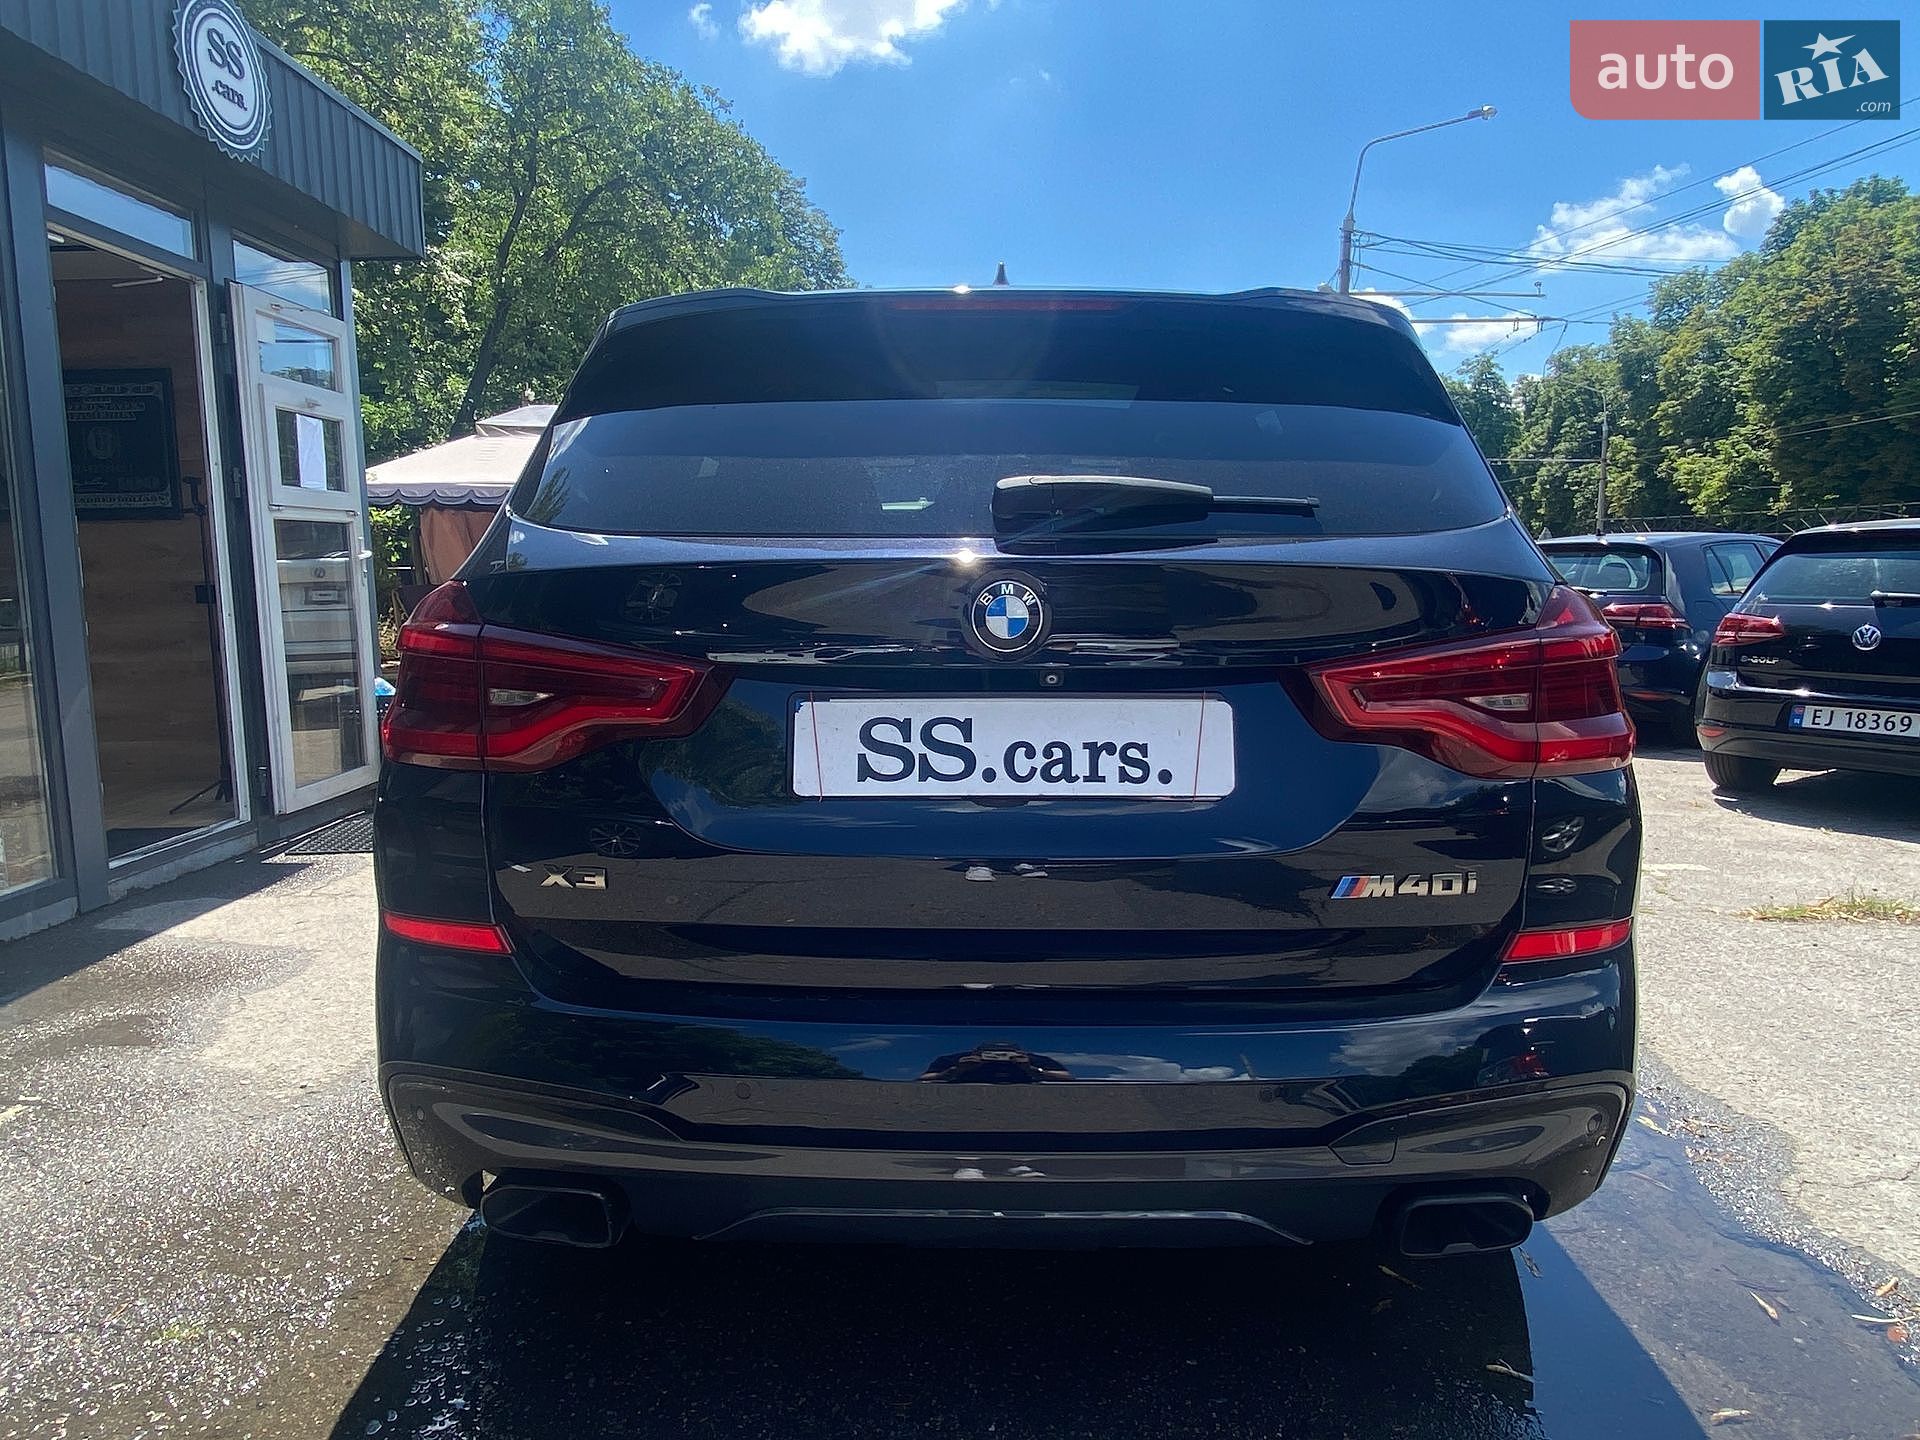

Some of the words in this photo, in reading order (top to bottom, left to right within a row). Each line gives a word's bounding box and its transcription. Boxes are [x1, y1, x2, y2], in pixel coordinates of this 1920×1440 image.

[207, 28, 245, 80] SS
[979, 583, 1036, 606] BMW
[1811, 709, 1835, 726] EJ
[1845, 711, 1913, 733] 18369
[540, 864, 607, 890] X3
[1360, 872, 1477, 898] M40i
